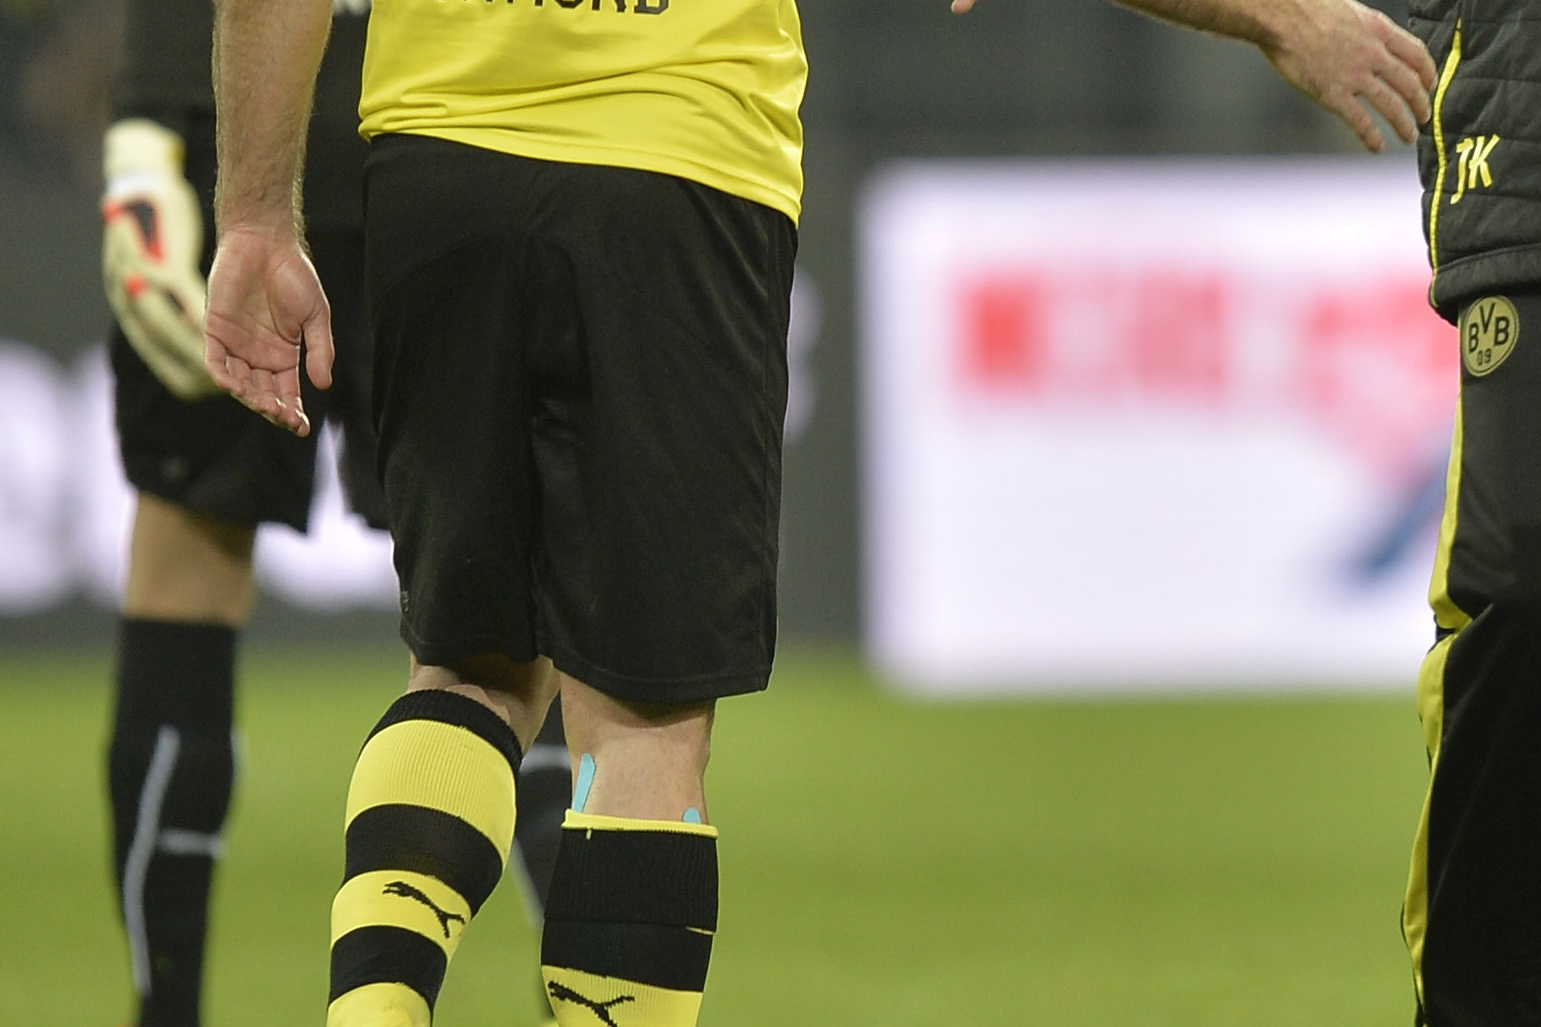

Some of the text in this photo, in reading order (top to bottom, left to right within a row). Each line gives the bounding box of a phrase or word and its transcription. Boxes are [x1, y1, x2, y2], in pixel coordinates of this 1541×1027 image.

[1450, 134, 1500, 205] JK
[1469, 302, 1510, 354] BVB
[1477, 348, 1493, 366] 09
